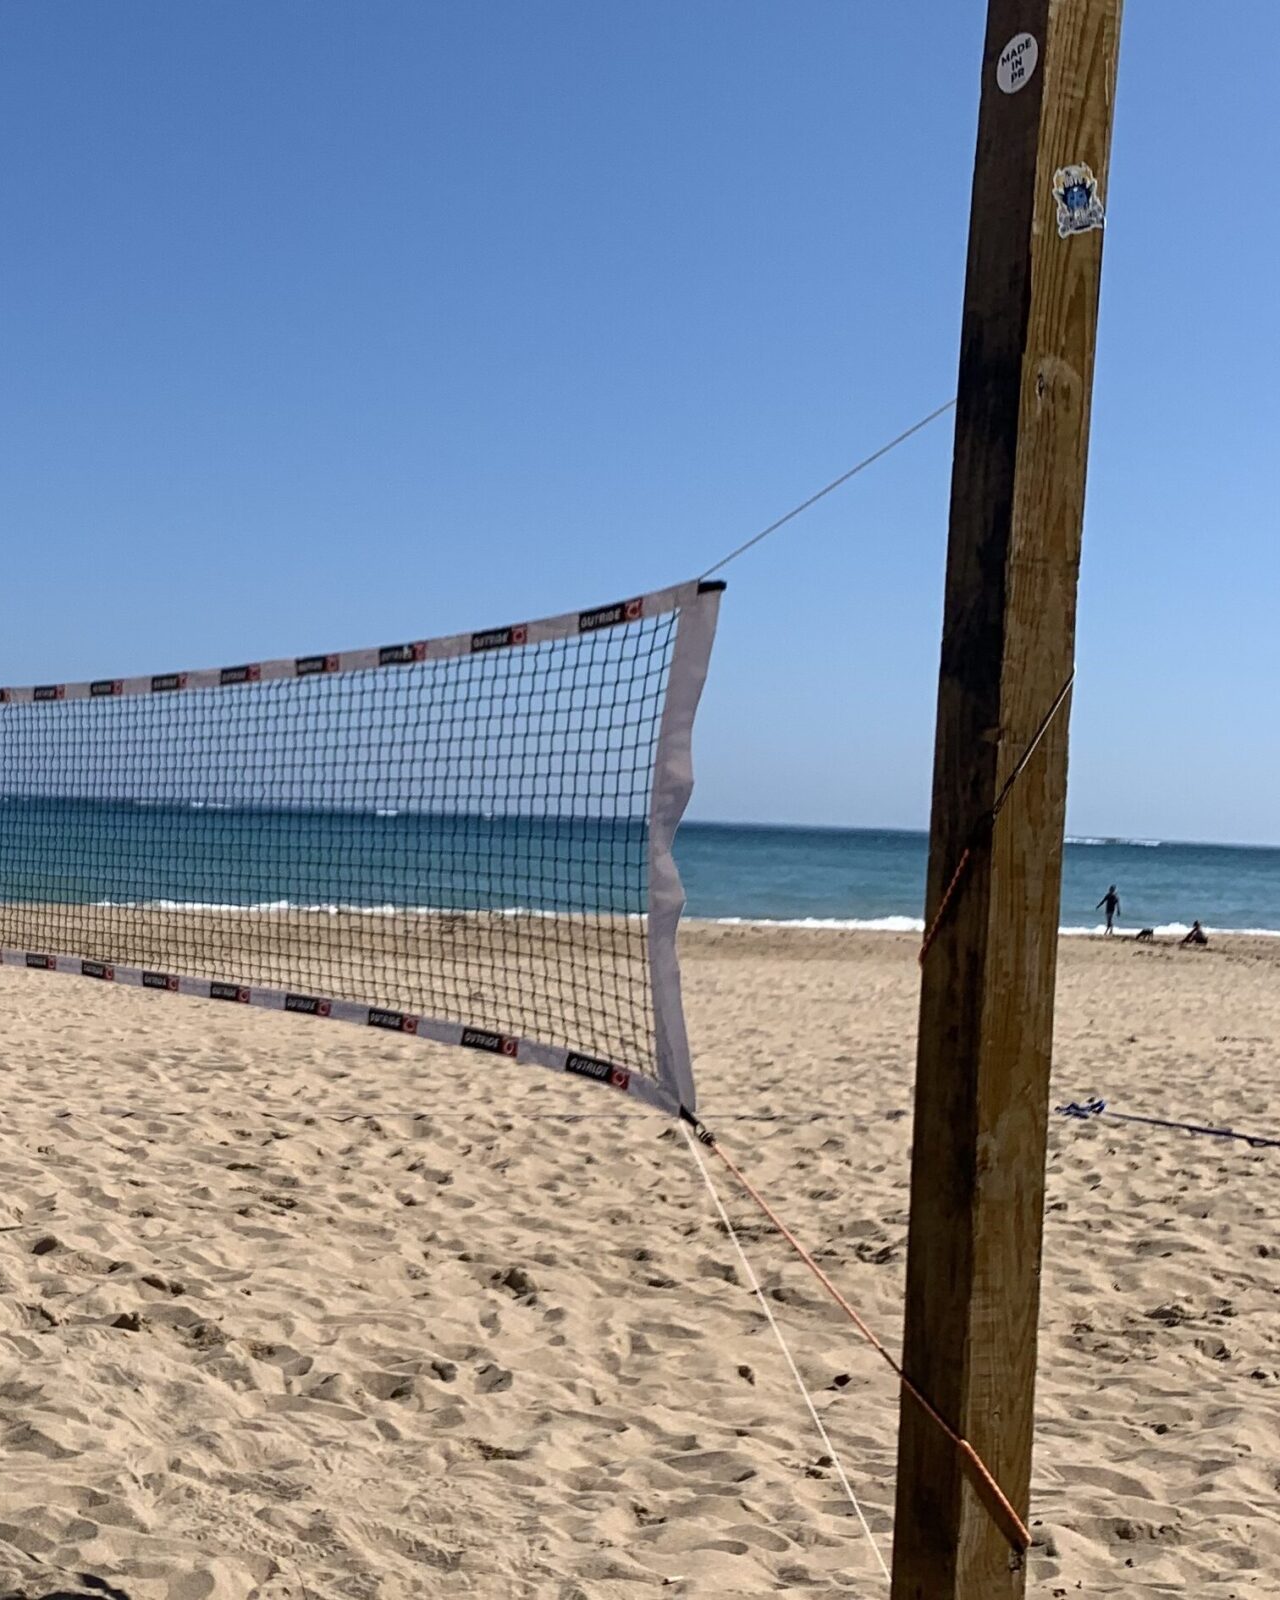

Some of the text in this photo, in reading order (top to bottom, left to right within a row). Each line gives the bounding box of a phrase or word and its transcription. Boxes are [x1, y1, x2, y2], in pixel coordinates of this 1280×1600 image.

[1001, 37, 1031, 66] MADE
[1011, 56, 1022, 71] IN
[1011, 67, 1024, 83] PR
